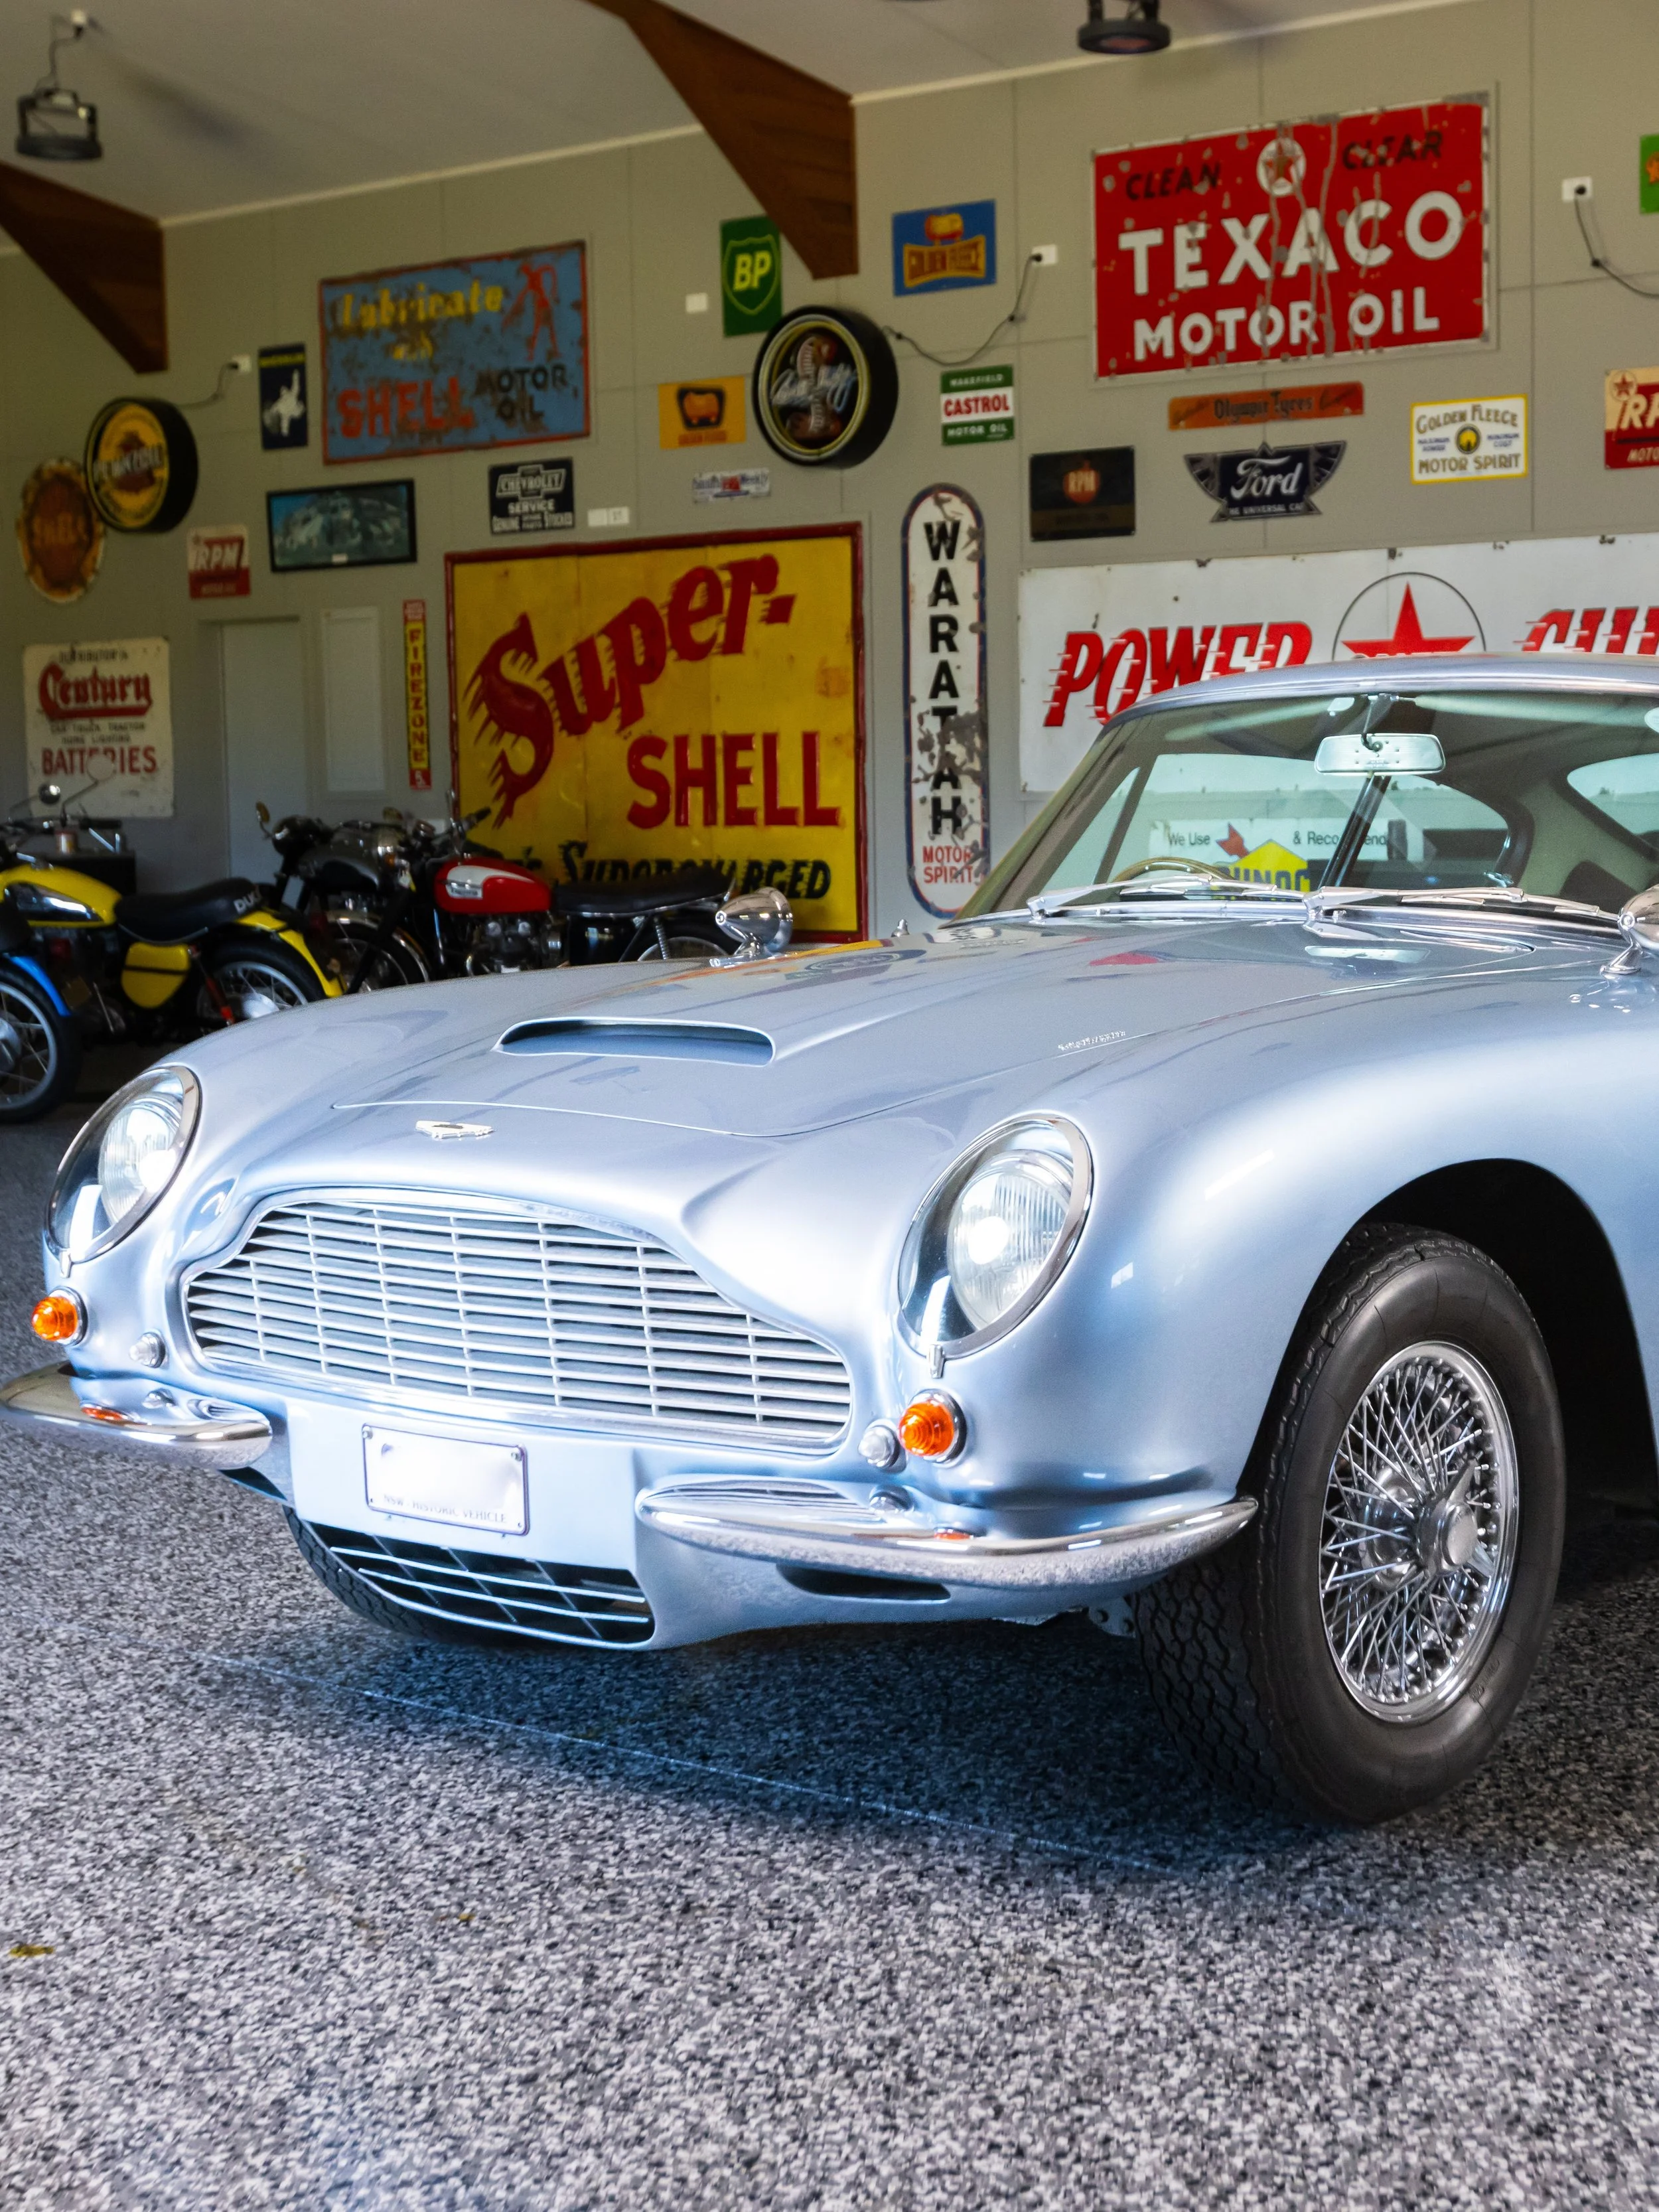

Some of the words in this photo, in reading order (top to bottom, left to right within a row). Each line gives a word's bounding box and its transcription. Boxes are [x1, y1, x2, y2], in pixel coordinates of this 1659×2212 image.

[1126, 161, 1222, 201] CLEAN
[1342, 129, 1443, 171] CLEAR
[1118, 190, 1464, 296] TEXACO
[733, 250, 772, 291] BP
[1133, 299, 1319, 362] MOTOR
[1347, 286, 1440, 337] OIL
[474, 363, 567, 398] MOTOR
[337, 375, 476, 439] SHELL
[496, 390, 545, 423] OIL
[944, 394, 1010, 417] CASTROL
[1213, 398, 1269, 423] Olympic
[1269, 390, 1314, 419] Tyres
[1415, 409, 1468, 435] GOLDEN
[1471, 404, 1519, 427] FLEECE
[947, 424, 985, 437] MOTOR
[989, 423, 1007, 433] OIL
[1230, 455, 1304, 500] Ford
[1418, 456, 1469, 475] MOTOR
[1473, 453, 1521, 471] SPIRIT
[501, 473, 561, 492] CHEVROLET
[1068, 470, 1096, 493] RPM
[508, 498, 555, 515] SERVICE
[1288, 502, 1303, 511] CA
[195, 543, 239, 570] RPM
[38, 662, 153, 719] Century
[408, 627, 425, 763] FIREZONE
[465, 553, 796, 830] Super-
[626, 730, 841, 830] SHELL
[922, 845, 974, 865] MOTOR
[1168, 832, 1186, 846] We
[1188, 832, 1211, 846] Use
[1293, 832, 1302, 846] &
[1307, 832, 1388, 846] Recoend
[923, 865, 974, 884] SPIRIT
[384, 1494, 403, 1507] NSW
[412, 1497, 459, 1517] HISTORIC
[463, 1509, 507, 1524] VEHICLE
